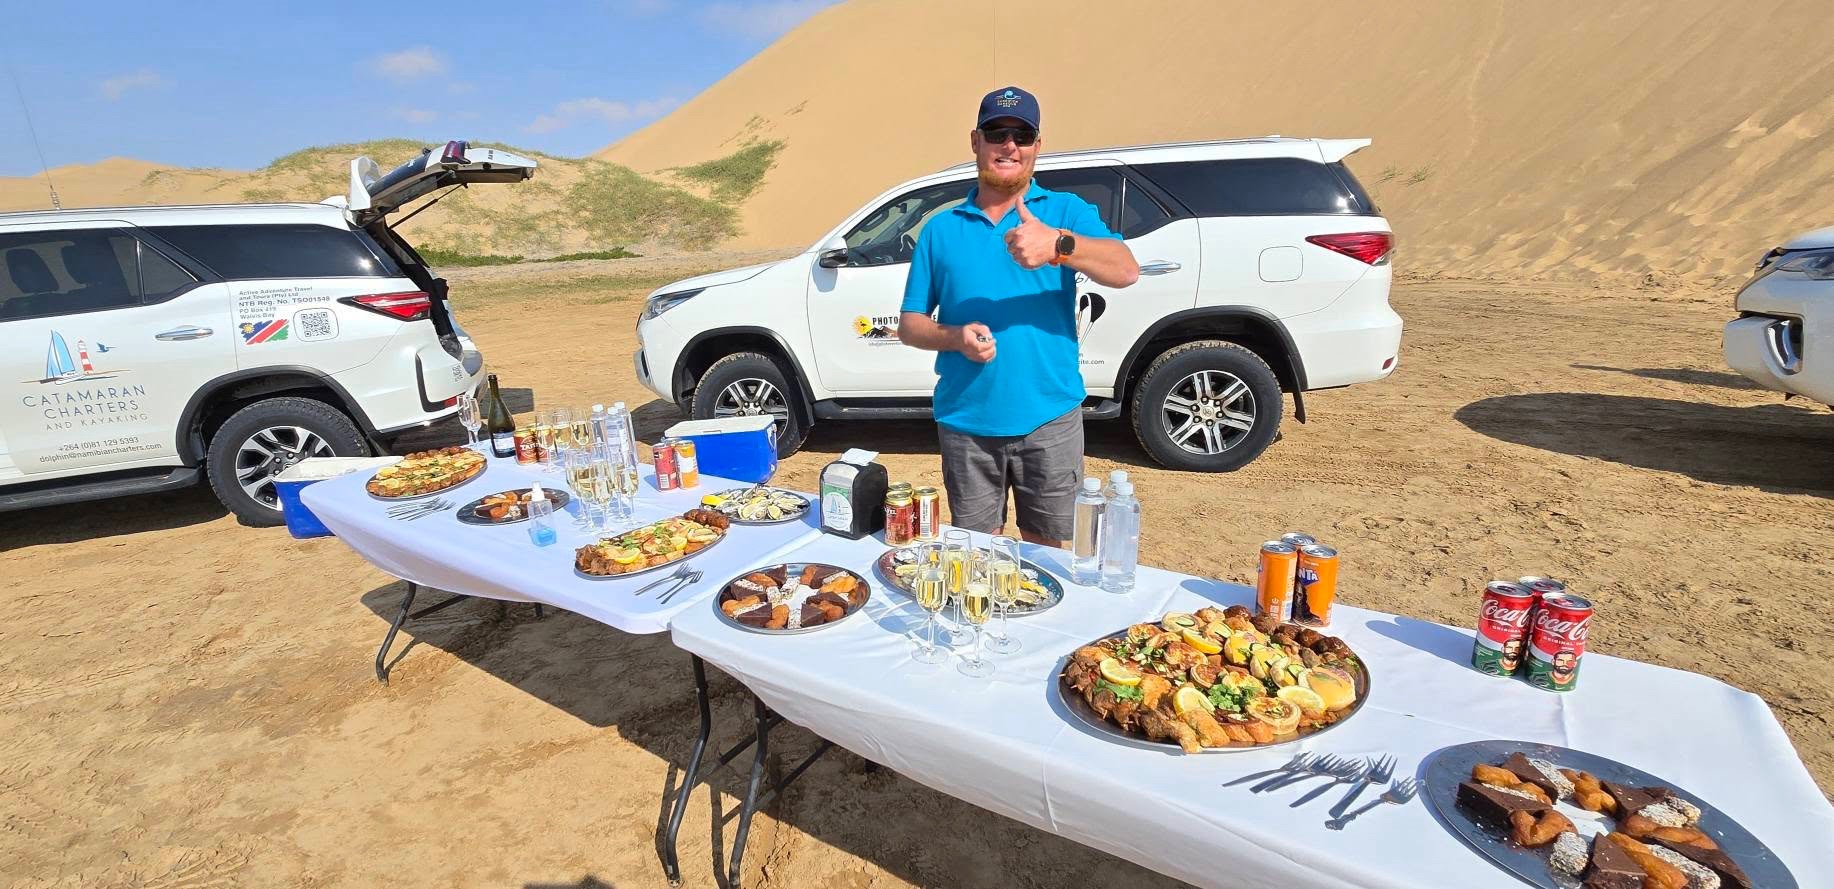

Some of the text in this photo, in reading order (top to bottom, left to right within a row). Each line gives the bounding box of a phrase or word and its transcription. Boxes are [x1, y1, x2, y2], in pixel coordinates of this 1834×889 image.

[872, 316, 899, 325] PHOTO
[22, 384, 146, 407] CATAMARAN
[44, 400, 139, 419] CHARTERS
[46, 412, 148, 431] AND KAYAKING
[39, 442, 162, 463] dolphin@namibiancharters.com
[58, 436, 139, 452] +264 (0)81 129 5393
[1298, 567, 1319, 581] NTA
